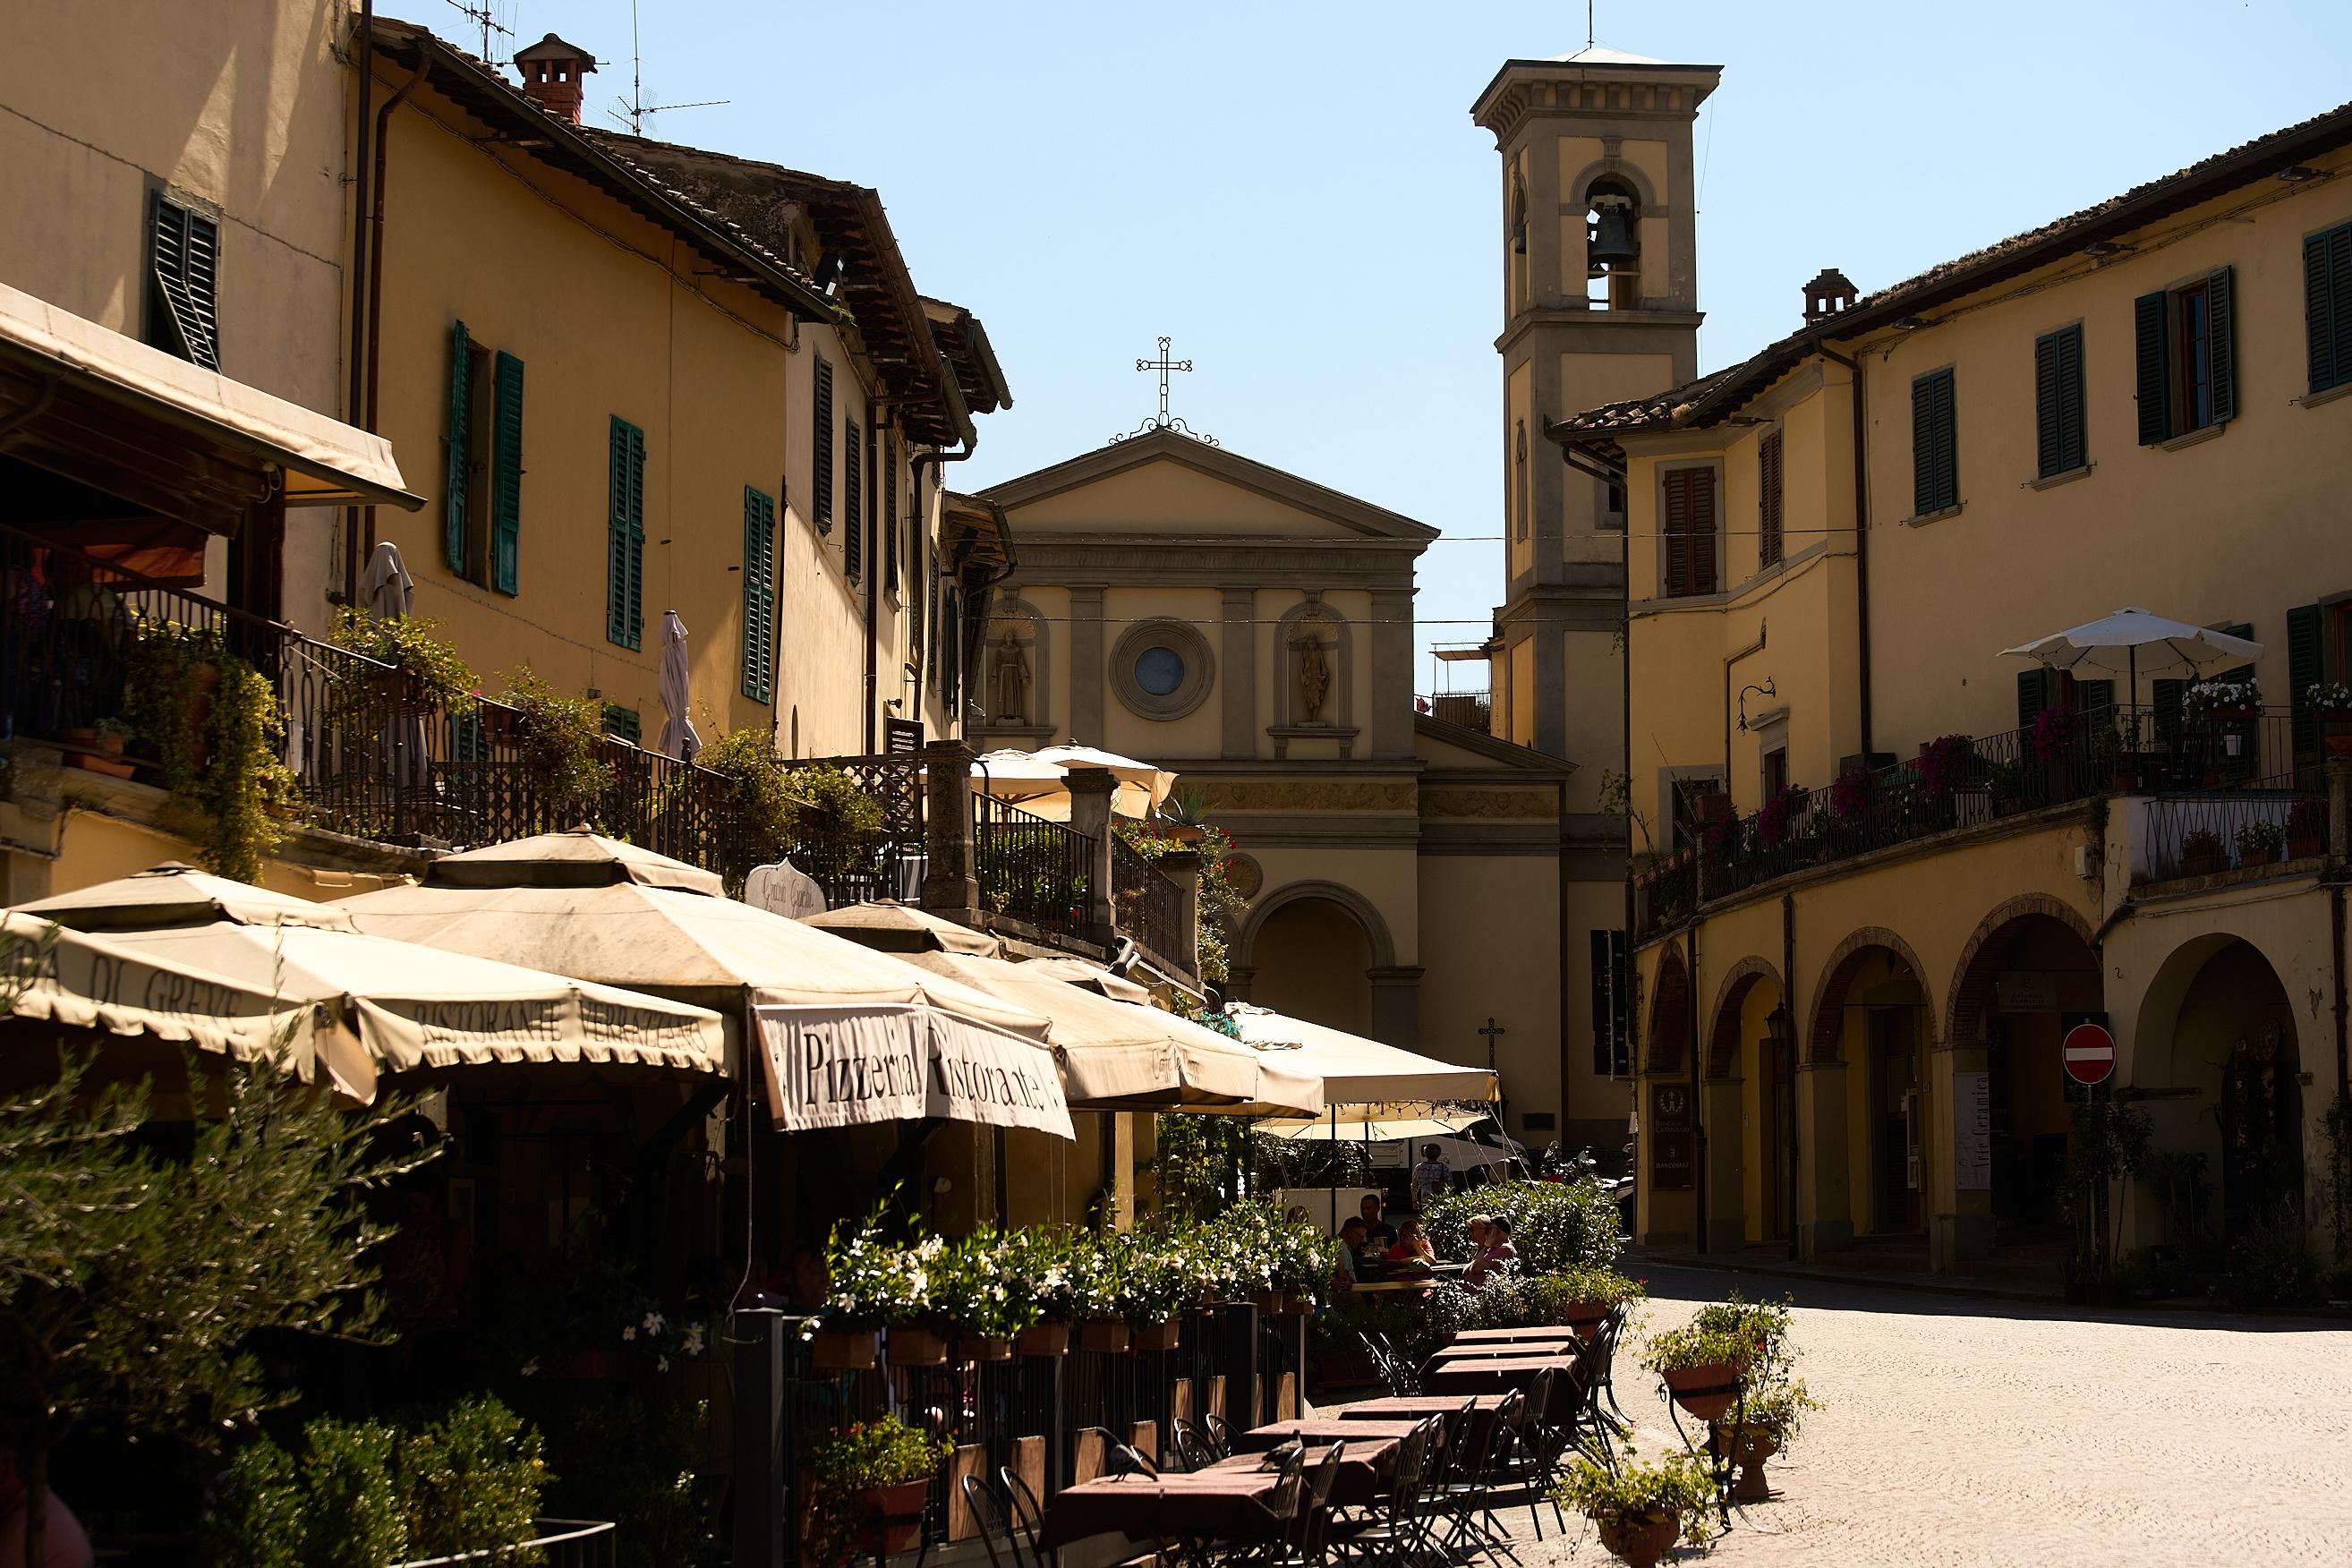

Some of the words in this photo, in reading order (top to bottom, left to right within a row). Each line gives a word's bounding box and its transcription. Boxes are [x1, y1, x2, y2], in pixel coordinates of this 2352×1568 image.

[89, 954, 125, 1009] DI
[144, 967, 245, 1035] GREVE
[413, 999, 562, 1045] RISTORANTE
[579, 1000, 708, 1054] VERRAZZANO
[803, 1028, 917, 1106] Pizzeria
[928, 1025, 1046, 1112] Ristorante
[1972, 1077, 1989, 1136] Ceramica
[1973, 1143, 1990, 1167] Arte
